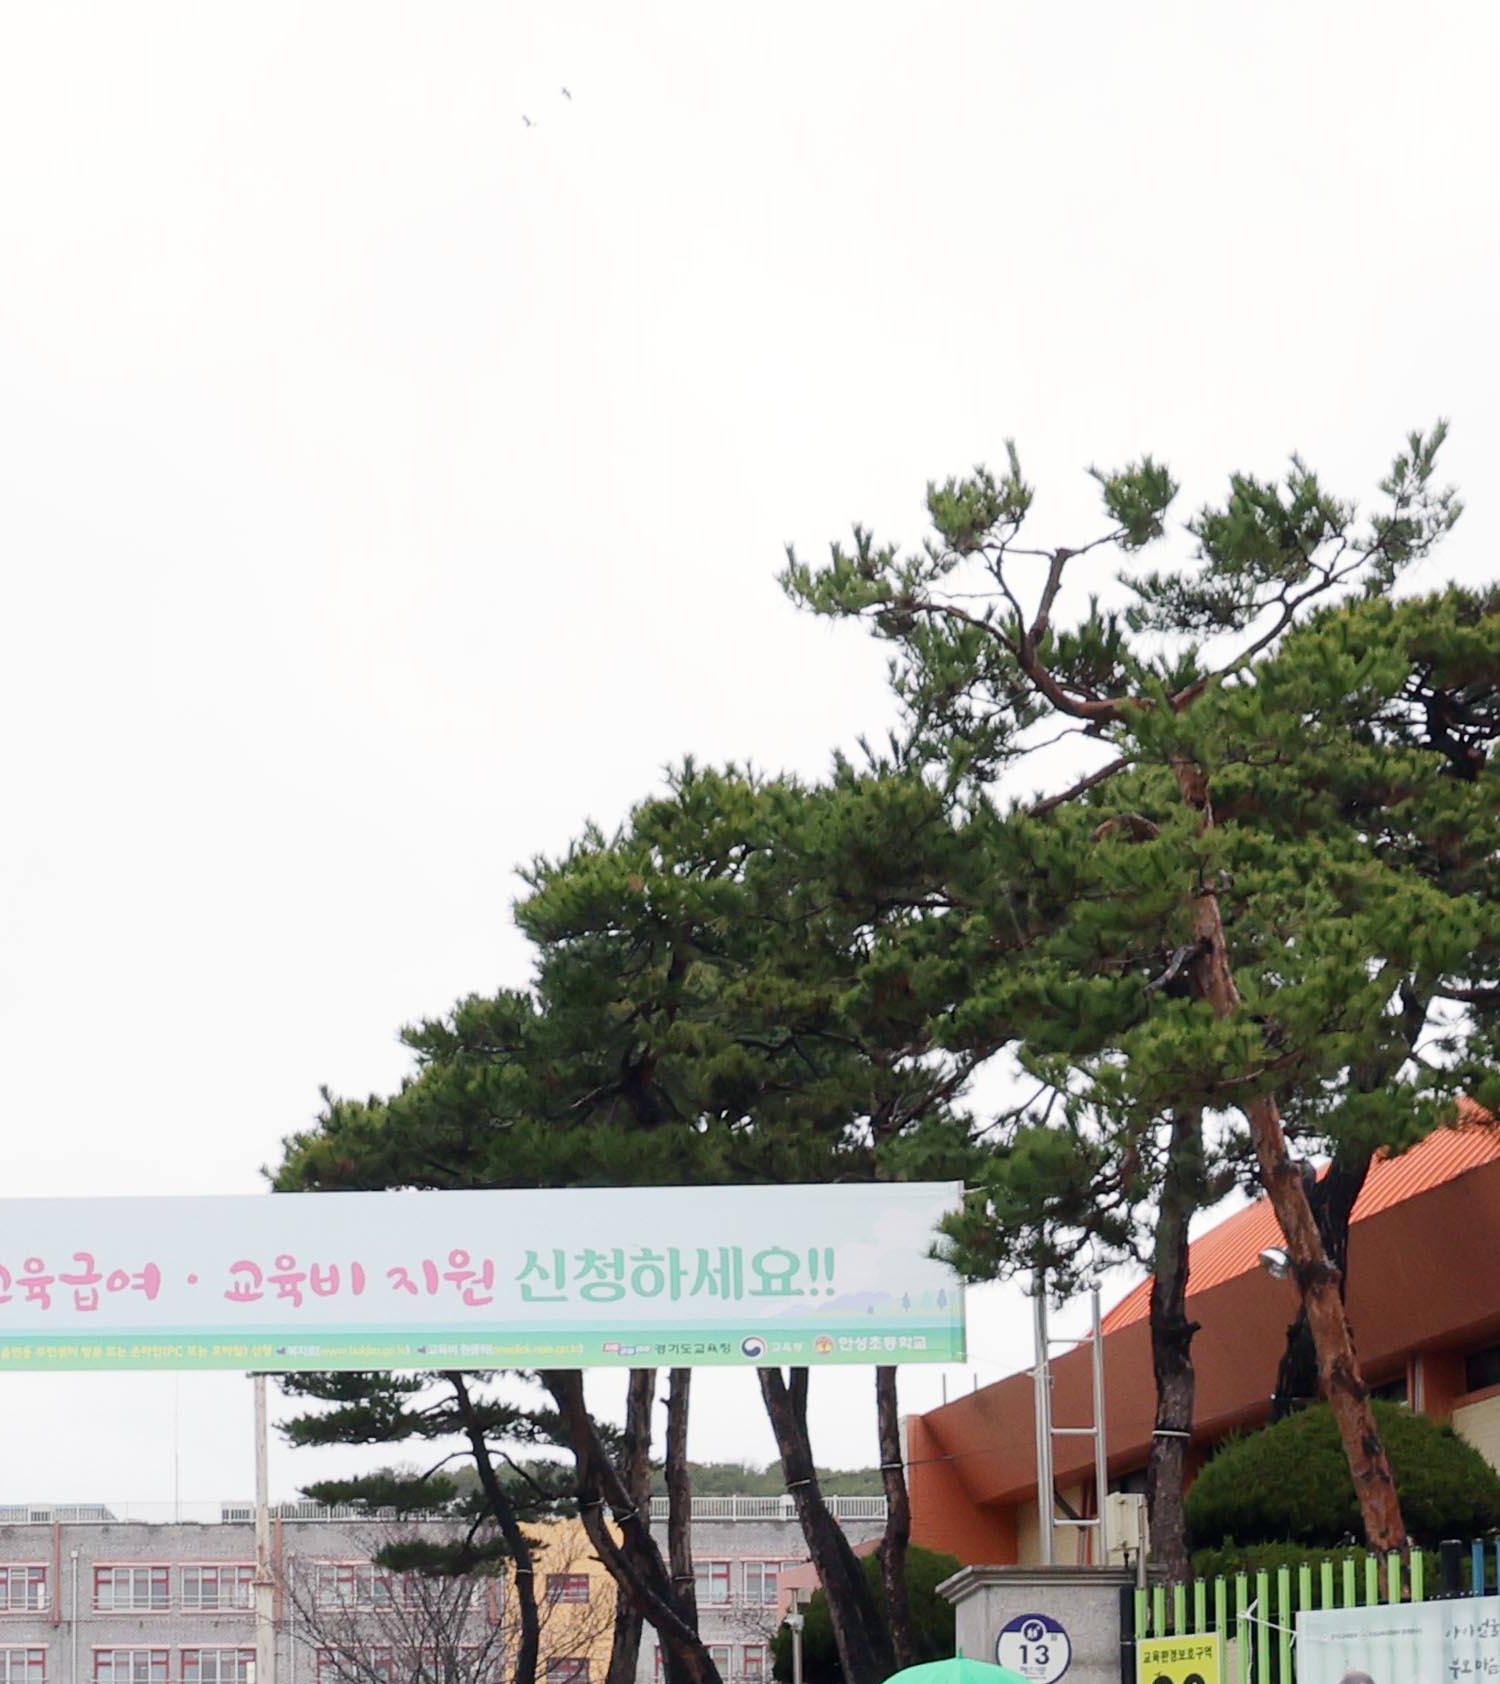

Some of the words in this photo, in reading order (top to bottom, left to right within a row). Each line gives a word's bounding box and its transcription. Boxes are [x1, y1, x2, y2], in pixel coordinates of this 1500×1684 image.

[223, 1253, 366, 1307] 교육비
[386, 1249, 495, 1306] 지원
[515, 1246, 836, 1302] 신청하세요!!
[655, 1343, 731, 1355] 경기도교육청
[838, 1335, 927, 1352] 안성초등학교
[1018, 1645, 1050, 1665] 13
[1143, 1645, 1213, 1664] 교육환경보호구역
